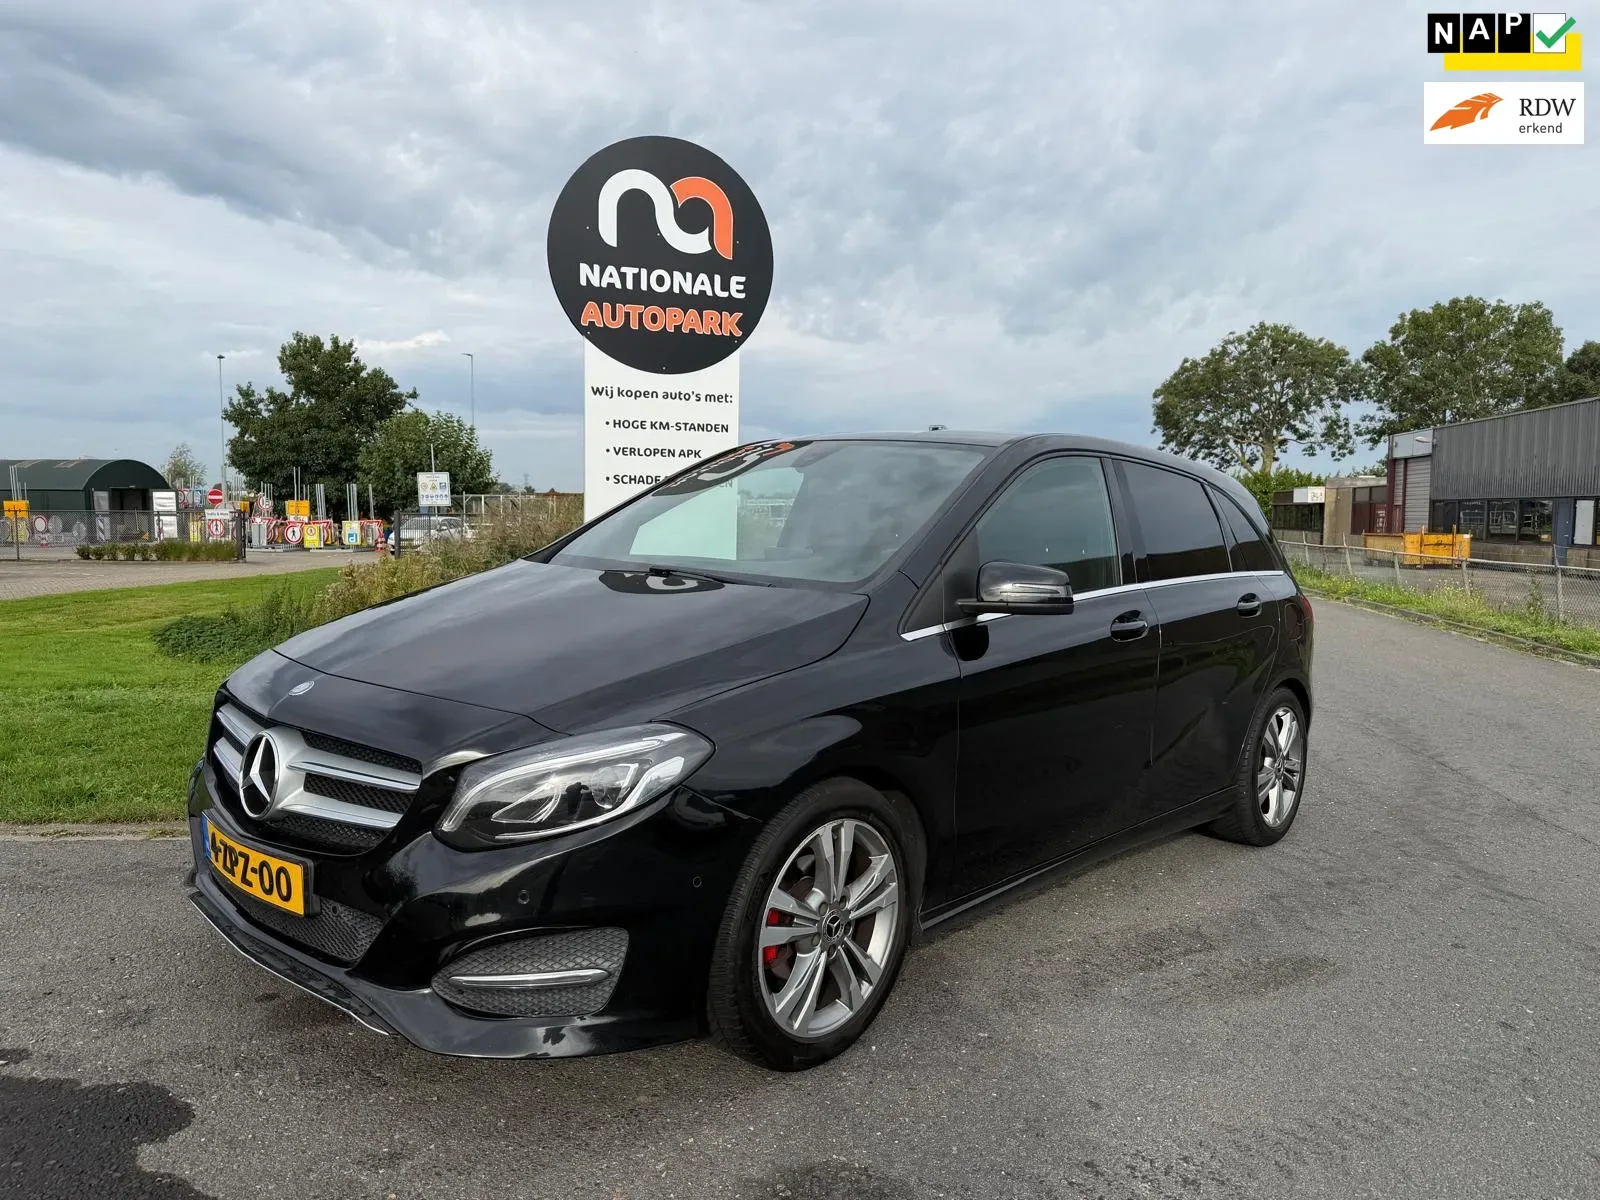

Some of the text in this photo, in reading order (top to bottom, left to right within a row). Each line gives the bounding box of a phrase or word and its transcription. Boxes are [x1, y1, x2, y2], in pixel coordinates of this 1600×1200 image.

[579, 262, 746, 299] NATIONALE
[580, 301, 743, 338] AUTOPARK
[591, 386, 733, 404] Wij kopen auto's met:
[613, 419, 729, 433] HOGE KM-STANDEN
[613, 446, 702, 459] VERLOPEN APK
